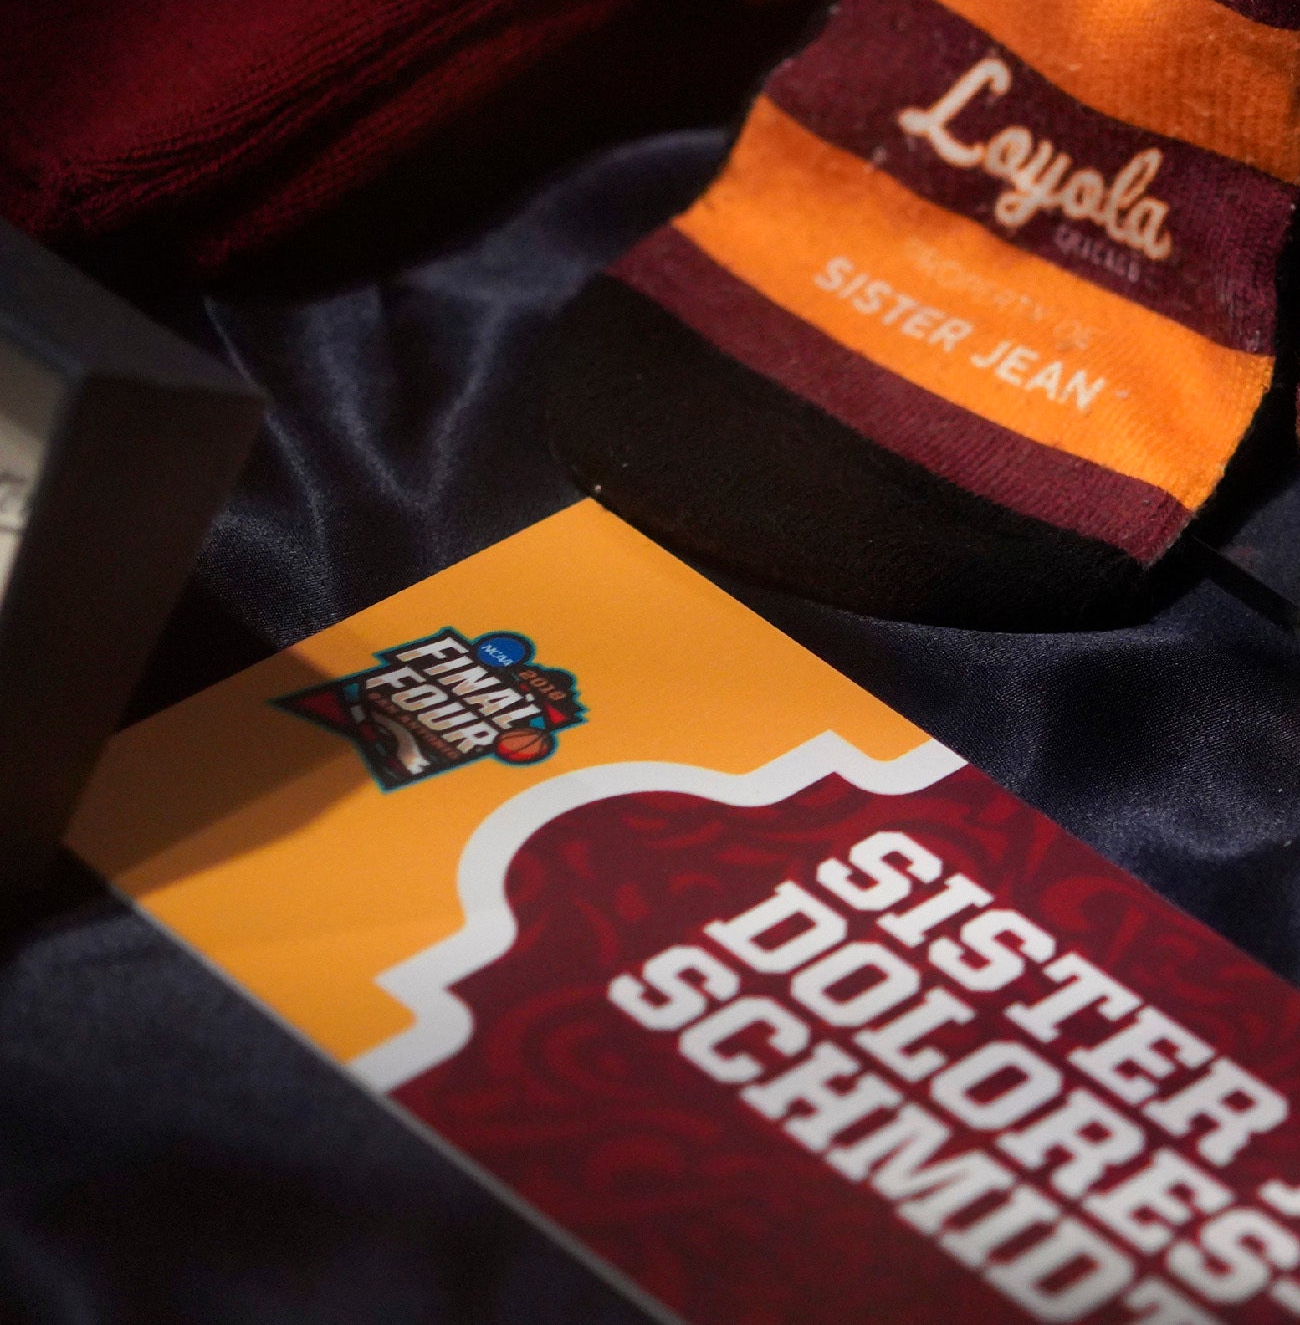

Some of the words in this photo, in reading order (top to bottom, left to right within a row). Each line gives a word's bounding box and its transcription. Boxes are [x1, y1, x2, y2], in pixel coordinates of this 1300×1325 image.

[898, 57, 1172, 261] Loyola
[814, 255, 973, 353] SISTER
[971, 339, 1105, 411] JEAN
[365, 666, 501, 755] FOUR
[396, 636, 542, 730] FINAL
[480, 643, 514, 668] NCAA
[814, 829, 1290, 1168] SISTER
